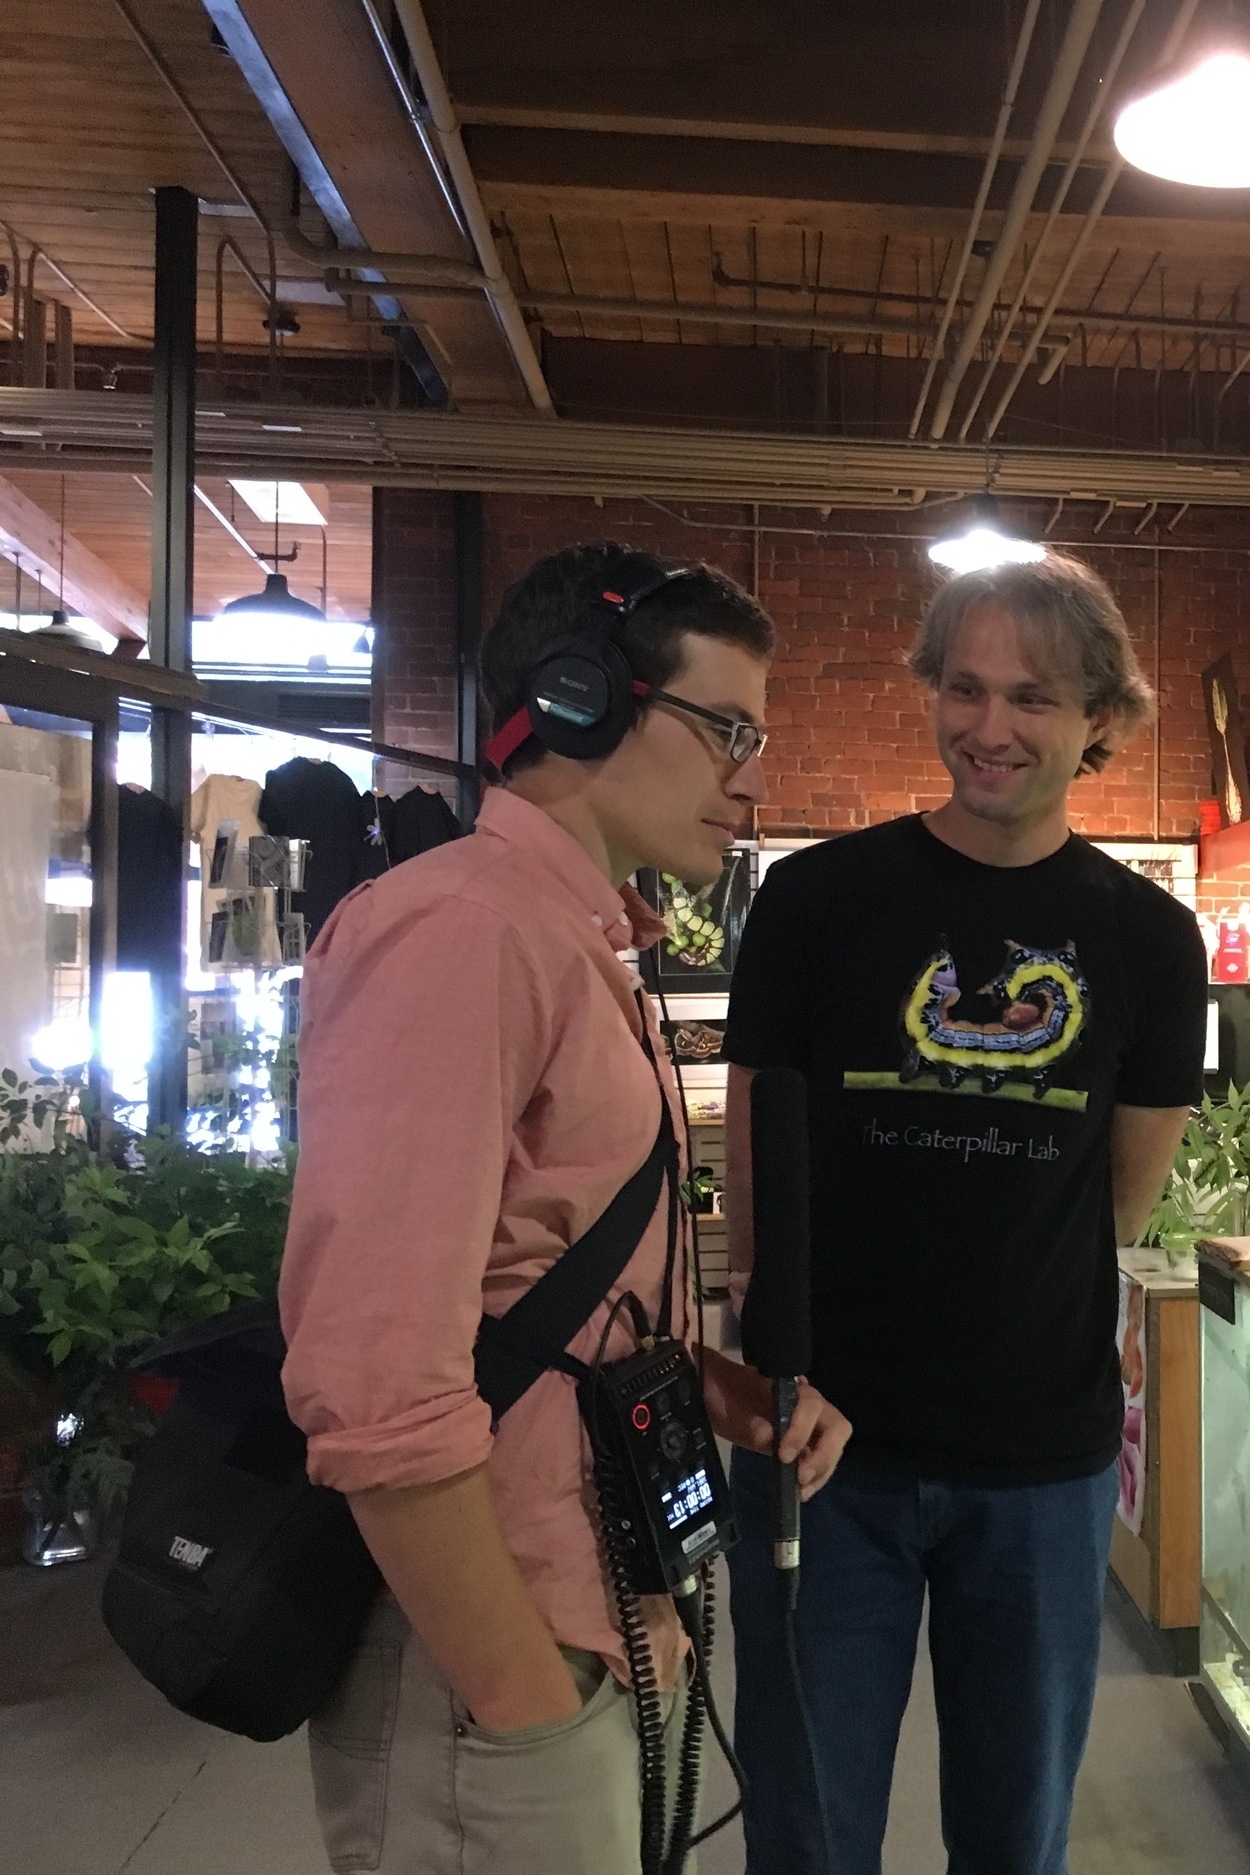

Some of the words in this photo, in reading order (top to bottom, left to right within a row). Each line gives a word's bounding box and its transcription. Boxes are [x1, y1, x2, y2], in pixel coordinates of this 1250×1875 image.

[862, 1118, 899, 1146] The
[903, 1126, 1024, 1163] Caterpillar
[1027, 1135, 1060, 1161] Lab
[169, 1536, 209, 1568] TENBA
